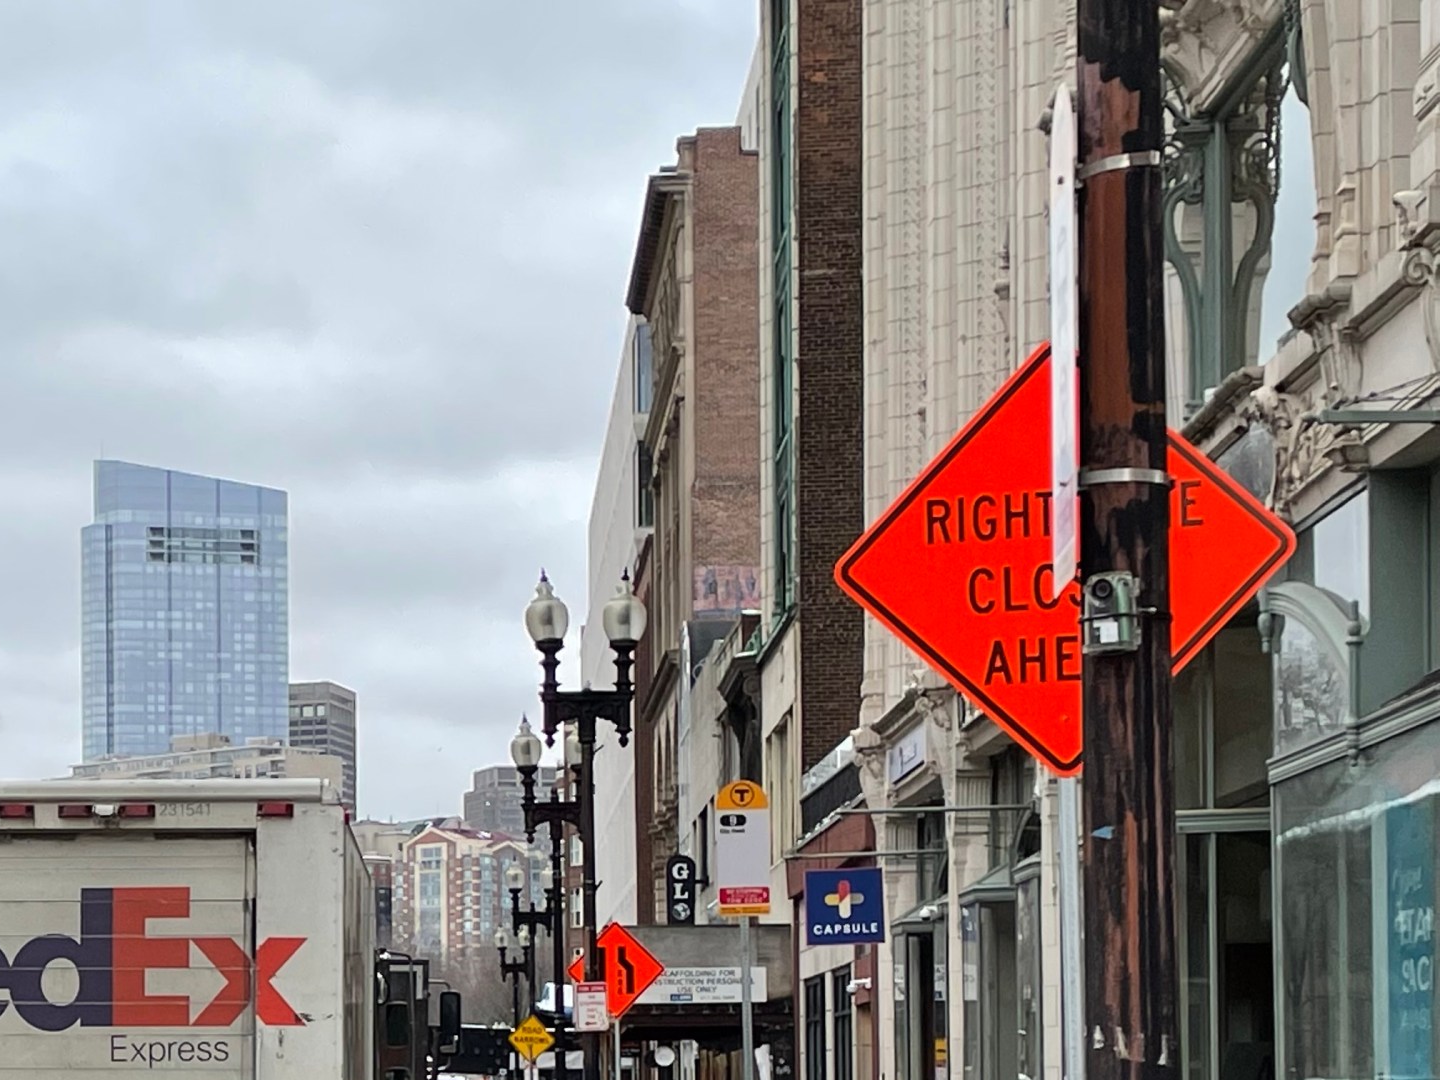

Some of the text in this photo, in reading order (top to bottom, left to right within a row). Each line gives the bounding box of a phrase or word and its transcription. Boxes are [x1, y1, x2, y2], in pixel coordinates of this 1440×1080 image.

[160, 803, 210, 816] 231541
[813, 922, 879, 936] CAPSULE
[110, 1034, 230, 1067] Express
